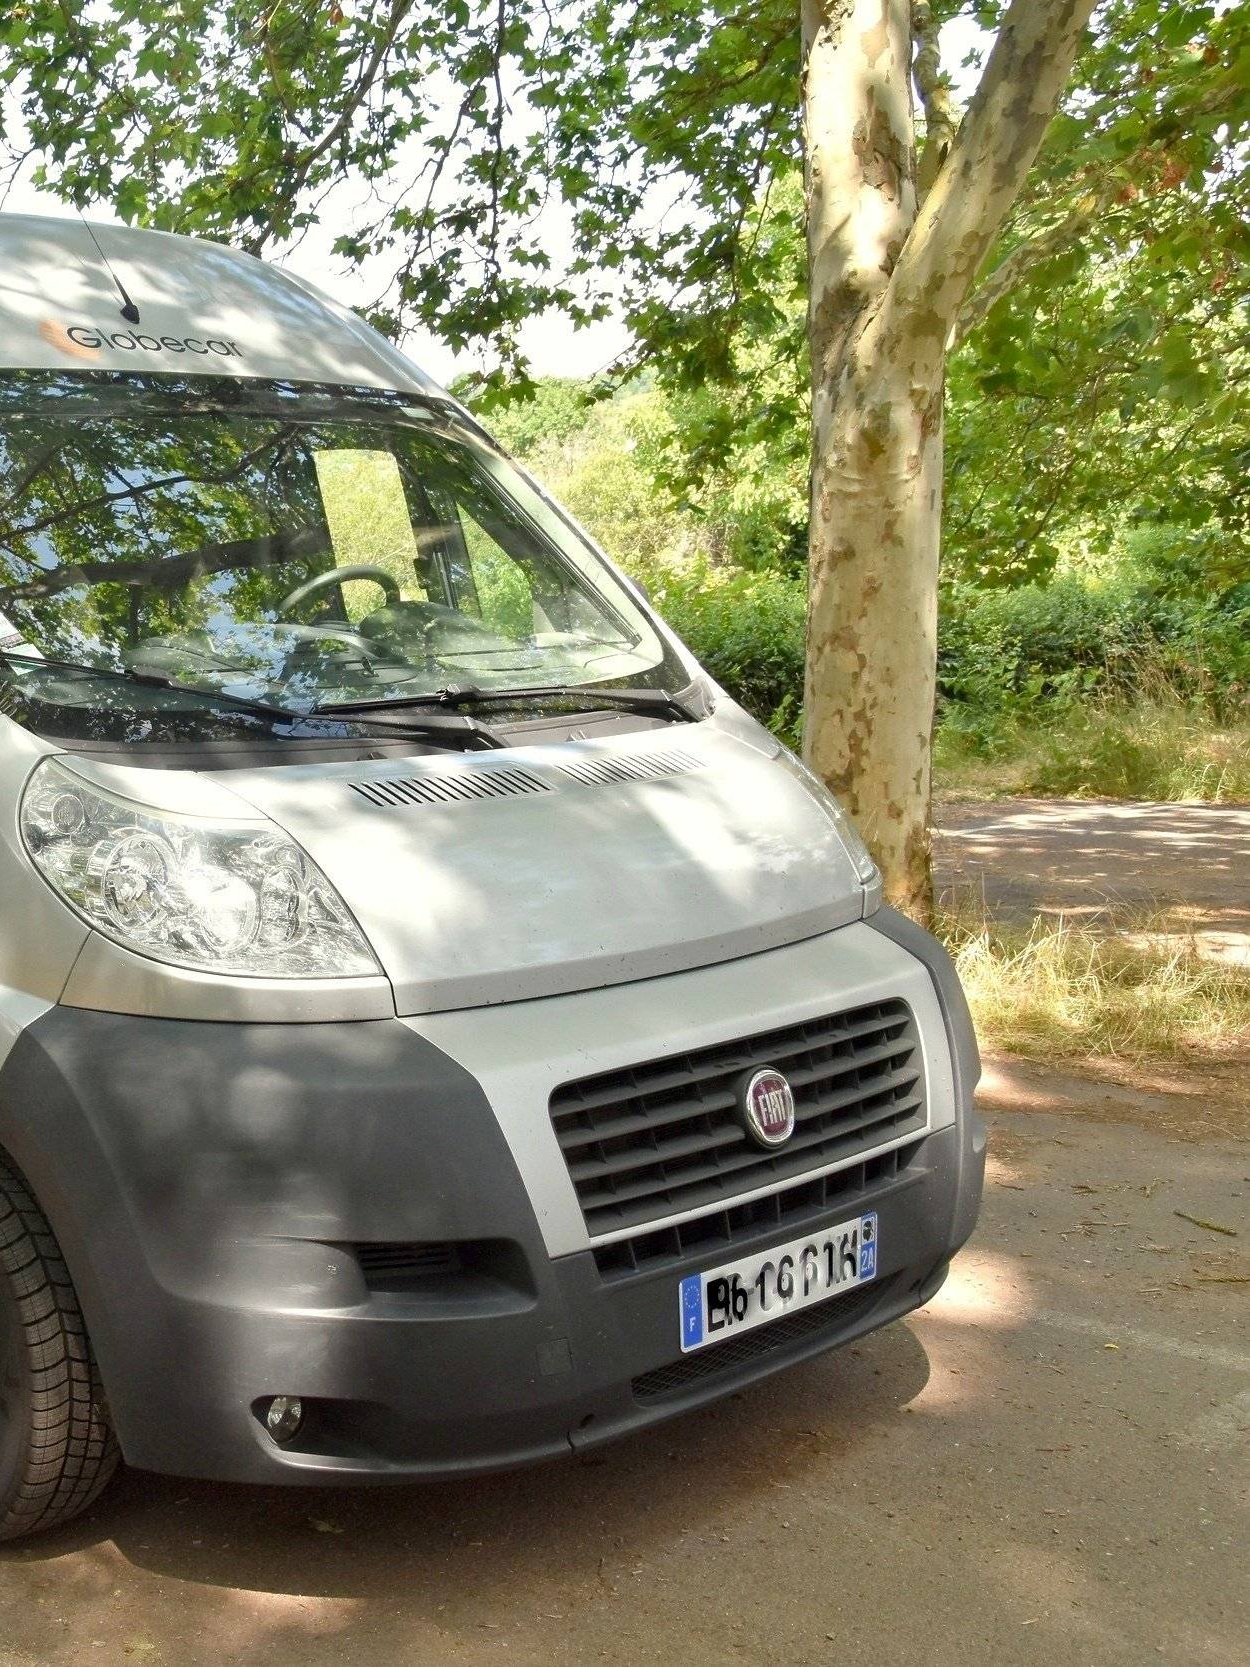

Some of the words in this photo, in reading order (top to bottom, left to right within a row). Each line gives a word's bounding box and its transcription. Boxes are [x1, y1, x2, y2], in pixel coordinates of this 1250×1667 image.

[67, 326, 244, 358] Globecar
[757, 1088, 787, 1127] FIAT
[861, 1247, 874, 1272] 2A
[688, 1316, 695, 1333] F
